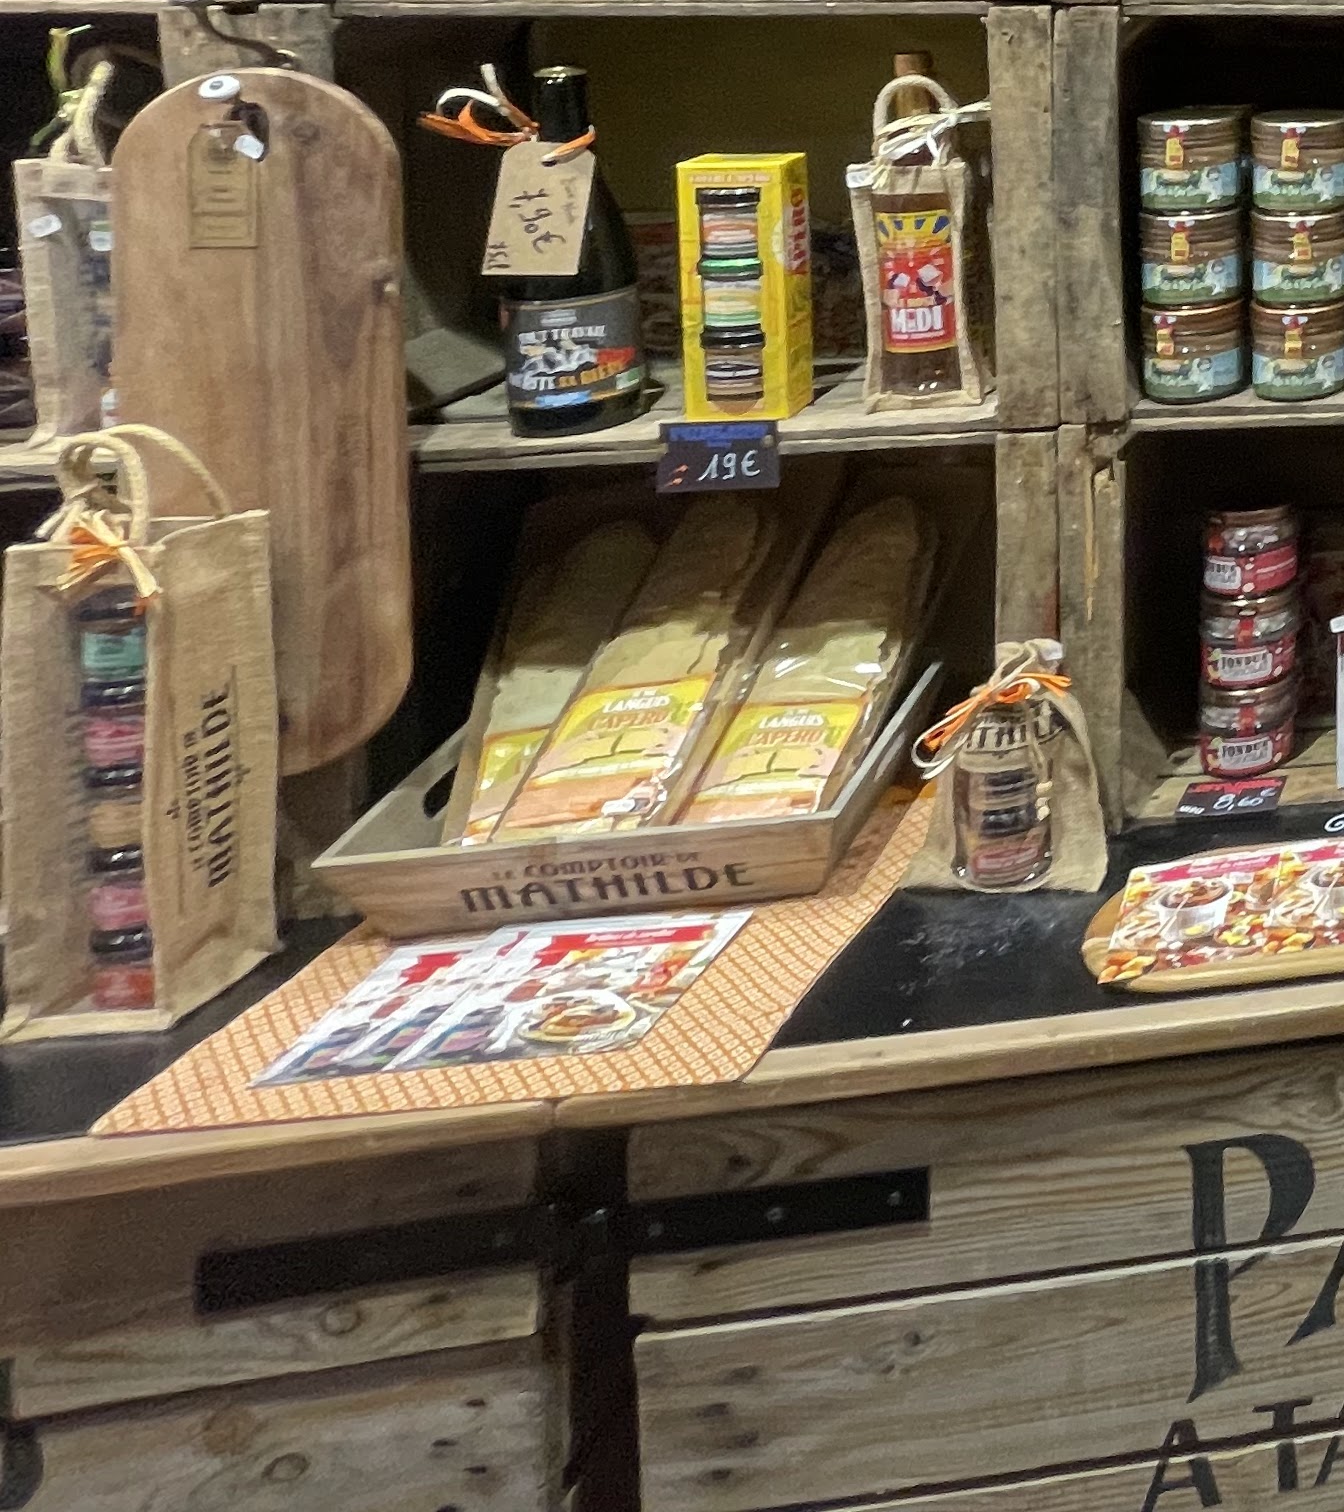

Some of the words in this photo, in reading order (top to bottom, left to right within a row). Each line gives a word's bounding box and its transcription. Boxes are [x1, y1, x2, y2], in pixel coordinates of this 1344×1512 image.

[697, 449, 761, 482] 19€
[202, 686, 234, 889] MATHILDE
[460, 863, 754, 913] MATHILDE
[1140, 1417, 1223, 1512] A
